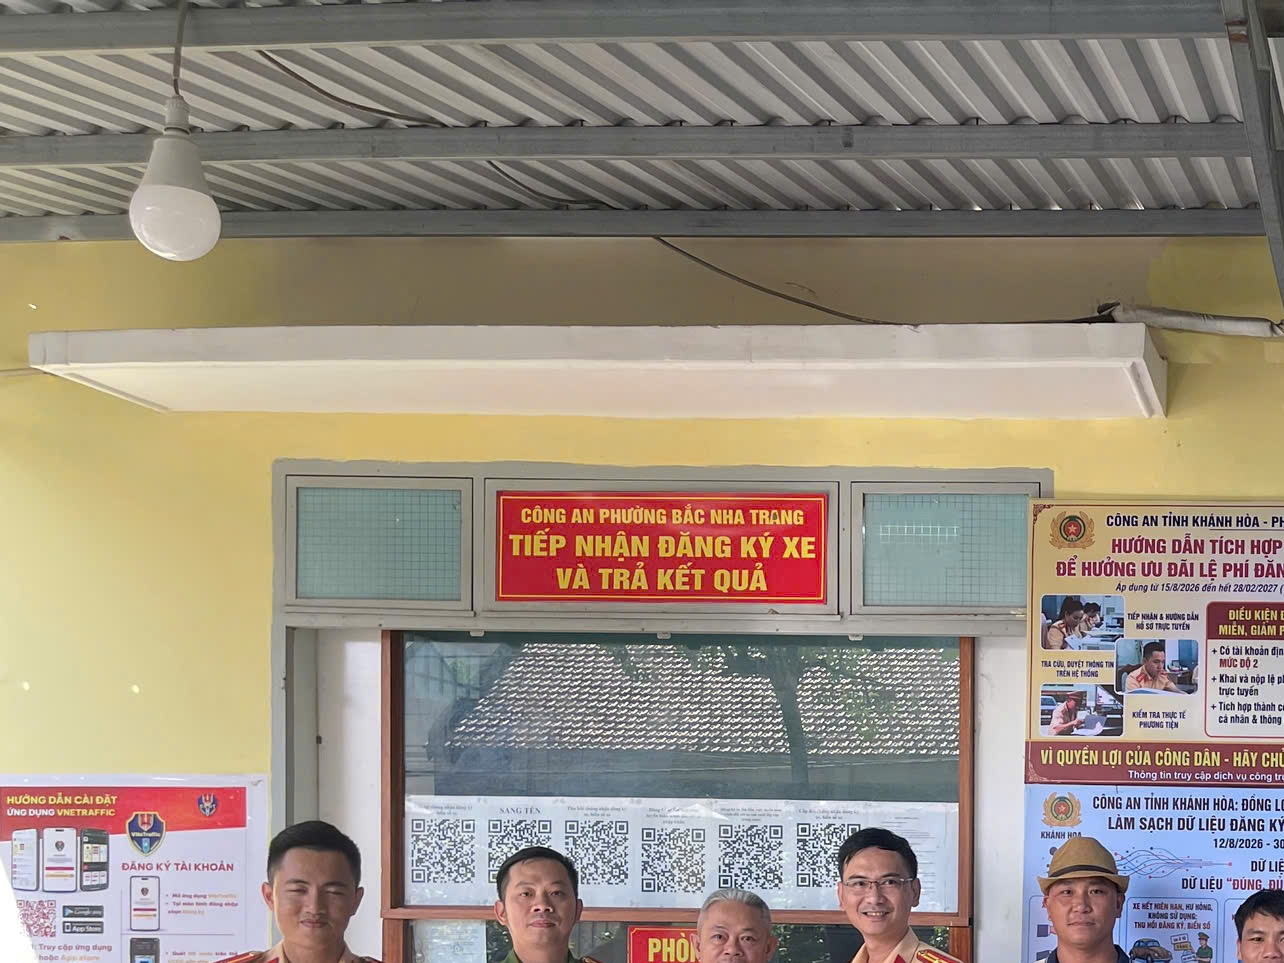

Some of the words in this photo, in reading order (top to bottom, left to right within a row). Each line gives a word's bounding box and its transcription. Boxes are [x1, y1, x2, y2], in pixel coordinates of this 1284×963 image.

[521, 505, 566, 524] CÔNG
[571, 509, 594, 524] AN
[600, 506, 667, 525] PHƯỜNG
[672, 504, 705, 524] BẮC
[710, 510, 744, 525] NHA
[750, 510, 804, 526] TRANG
[1107, 513, 1138, 527] CÔNG
[1142, 516, 1158, 527] AN
[1168, 512, 1188, 527] TỈNH
[1193, 513, 1232, 528] KHÁNH
[1236, 514, 1260, 528] HÒA
[509, 528, 566, 557] TIẾP
[576, 531, 650, 562] NHẬN
[658, 531, 732, 558] ĐĂNG
[741, 531, 774, 559] KÝ
[782, 537, 816, 559] XE
[1112, 534, 1166, 554] HƯỚNG
[1172, 533, 1205, 554] DẪN
[1210, 535, 1246, 554] TÍCH
[1250, 538, 1282, 558] HỢP
[556, 563, 590, 590] VÀ
[599, 562, 648, 590] TRẢ
[657, 561, 705, 591] KẾT
[714, 562, 768, 592] QUẢ
[1116, 583, 1126, 593] Áp
[1129, 584, 1148, 593] dụng
[1150, 583, 1159, 592] từ
[1161, 584, 1200, 592] 15/8/2026
[1202, 583, 1216, 592] đến
[1219, 583, 1231, 592] hết
[1233, 584, 1277, 593] 28/02/2027
[1220, 646, 1230, 656] Có
[1233, 646, 1242, 656] tài
[1245, 646, 1269, 656] khoản
[1129, 769, 1157, 781] Thông
[1160, 770, 1171, 779] tin
[1174, 772, 1192, 781] truy
[1195, 770, 1211, 781] cập
[1214, 771, 1233, 782] dịch
[1236, 773, 1247, 782] vụ
[1250, 772, 1272, 782] công
[7, 794, 46, 804] HƯỚNG
[49, 792, 72, 805] DẪN
[74, 794, 94, 804] CÀI
[95, 794, 117, 806] ĐẶT
[7, 808, 26, 816] ỨNG
[29, 809, 55, 818] DỤNG
[57, 809, 116, 817] VNETRAFFIC
[1213, 839, 1263, 849] 12/8/2026
[121, 861, 153, 871] ĐĂNG
[156, 860, 172, 871] KÝ
[175, 860, 192, 871] TÀI
[194, 860, 234, 871] KHOẢN
